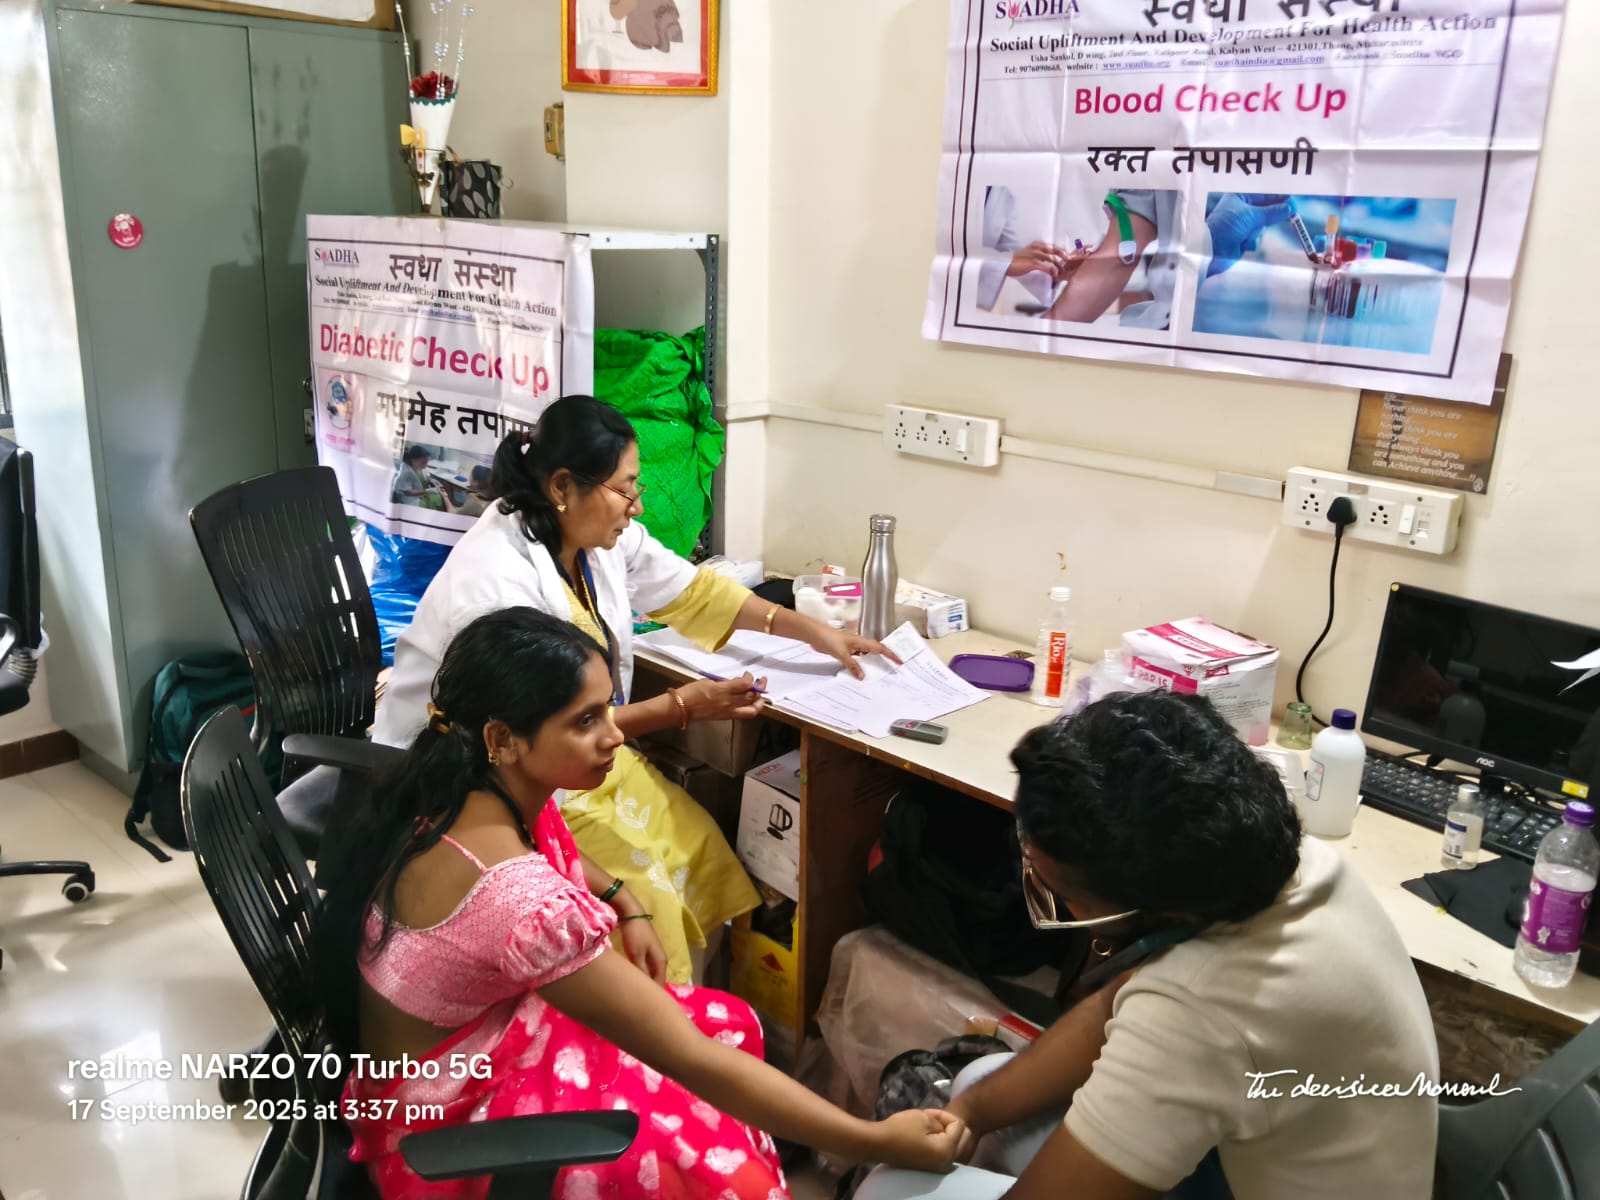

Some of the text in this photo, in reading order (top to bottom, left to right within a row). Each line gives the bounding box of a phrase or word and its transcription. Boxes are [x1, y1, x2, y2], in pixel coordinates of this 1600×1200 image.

[990, 14, 1497, 53] Social Upliftment And Development For Health Action
[1075, 83, 1347, 118] Blood Check Up
[1087, 136, 1318, 175] रक्त तपासणी
[388, 251, 517, 293] स्वधा संस्था
[315, 275, 338, 288] Social
[383, 282, 401, 293] And
[468, 291, 486, 304] For
[523, 300, 557, 318] Action
[320, 324, 549, 397] Diabetic Check Up
[376, 391, 450, 437] मधुमेह
[1388, 461, 1420, 472] Achieve
[1421, 446, 1442, 456] think
[1443, 451, 1460, 460] you
[1431, 459, 1449, 469] and
[1449, 462, 1465, 471] you
[1476, 757, 1495, 768] AOC
